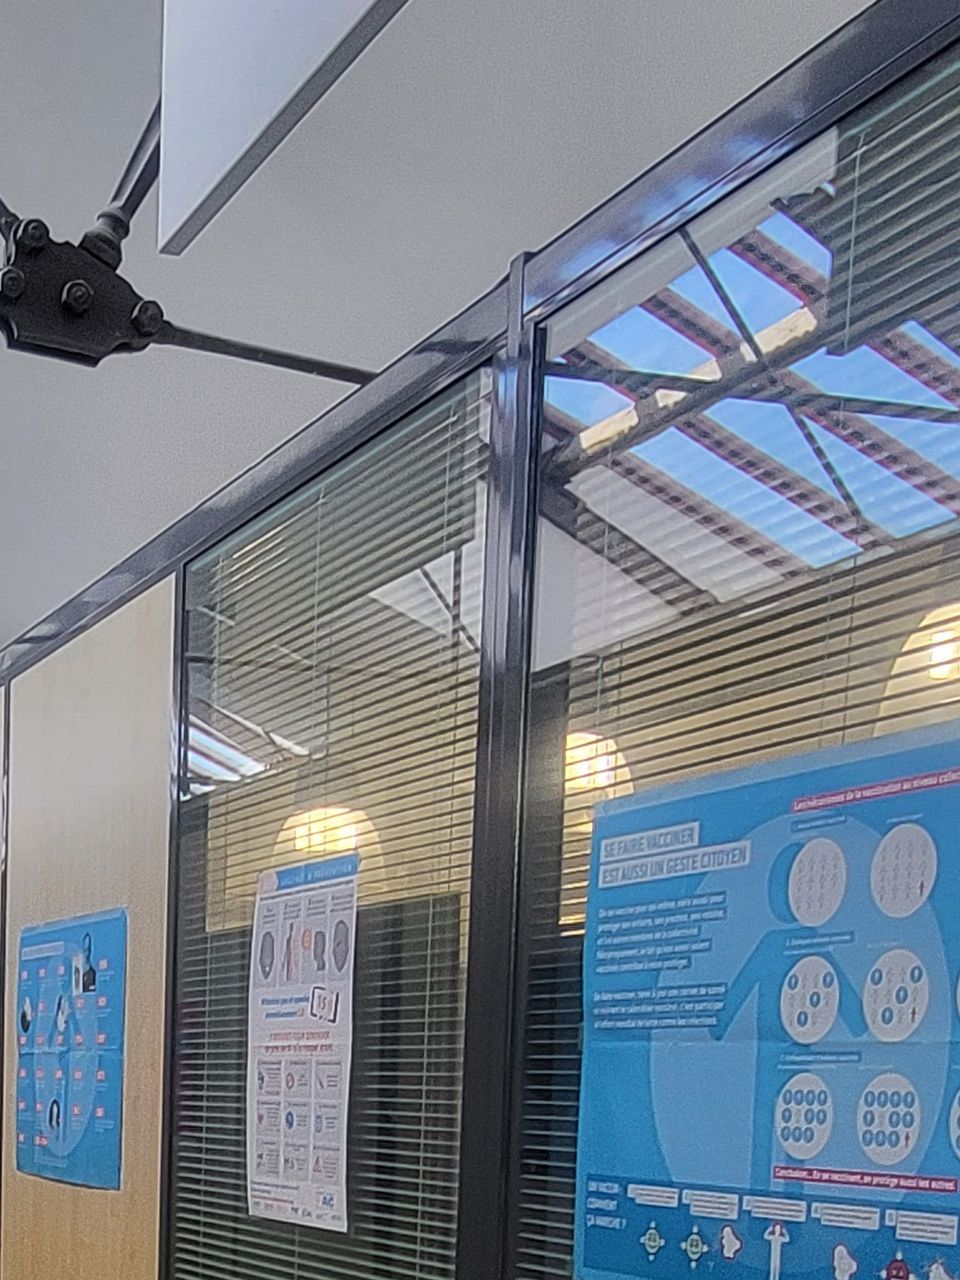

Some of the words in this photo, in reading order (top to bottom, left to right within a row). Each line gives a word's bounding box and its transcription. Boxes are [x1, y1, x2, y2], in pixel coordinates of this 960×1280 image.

[604, 843, 616, 858] SE
[618, 838, 645, 856] FAIRE
[647, 828, 695, 850] VACCINER
[602, 868, 620, 884] EST
[621, 863, 648, 882] AUSSI
[650, 861, 664, 876] UN
[666, 854, 698, 873] GESTE
[701, 846, 746, 869] CITOYEN
